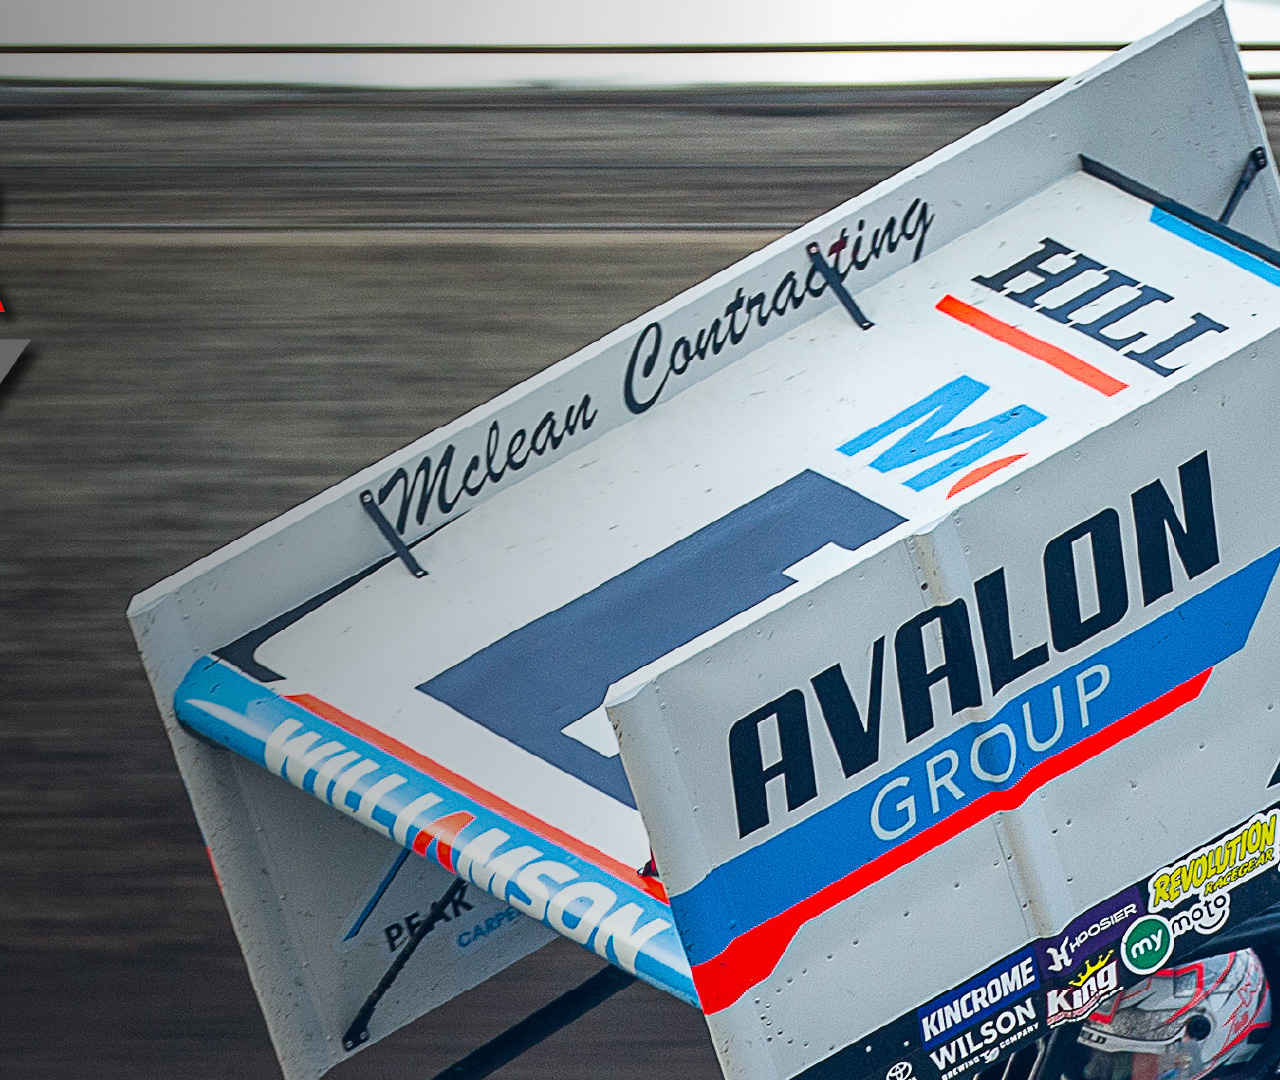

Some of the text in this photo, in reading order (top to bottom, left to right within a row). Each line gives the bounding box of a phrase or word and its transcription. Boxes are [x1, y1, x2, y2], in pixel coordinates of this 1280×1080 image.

[378, 197, 935, 536] Mclean Contracting
[728, 450, 1221, 839] AVALON
[871, 663, 1112, 842] GROUP
[263, 716, 674, 976] WILLIAMSON
[1152, 814, 1278, 907] REVOLUTION
[383, 880, 476, 953] PEK
[456, 905, 524, 949] CARPE
[1068, 902, 1138, 954] HOOSIER
[1130, 894, 1228, 960] my moto
[921, 956, 1036, 1042] KINCROME
[928, 996, 1037, 1071] WILSON
